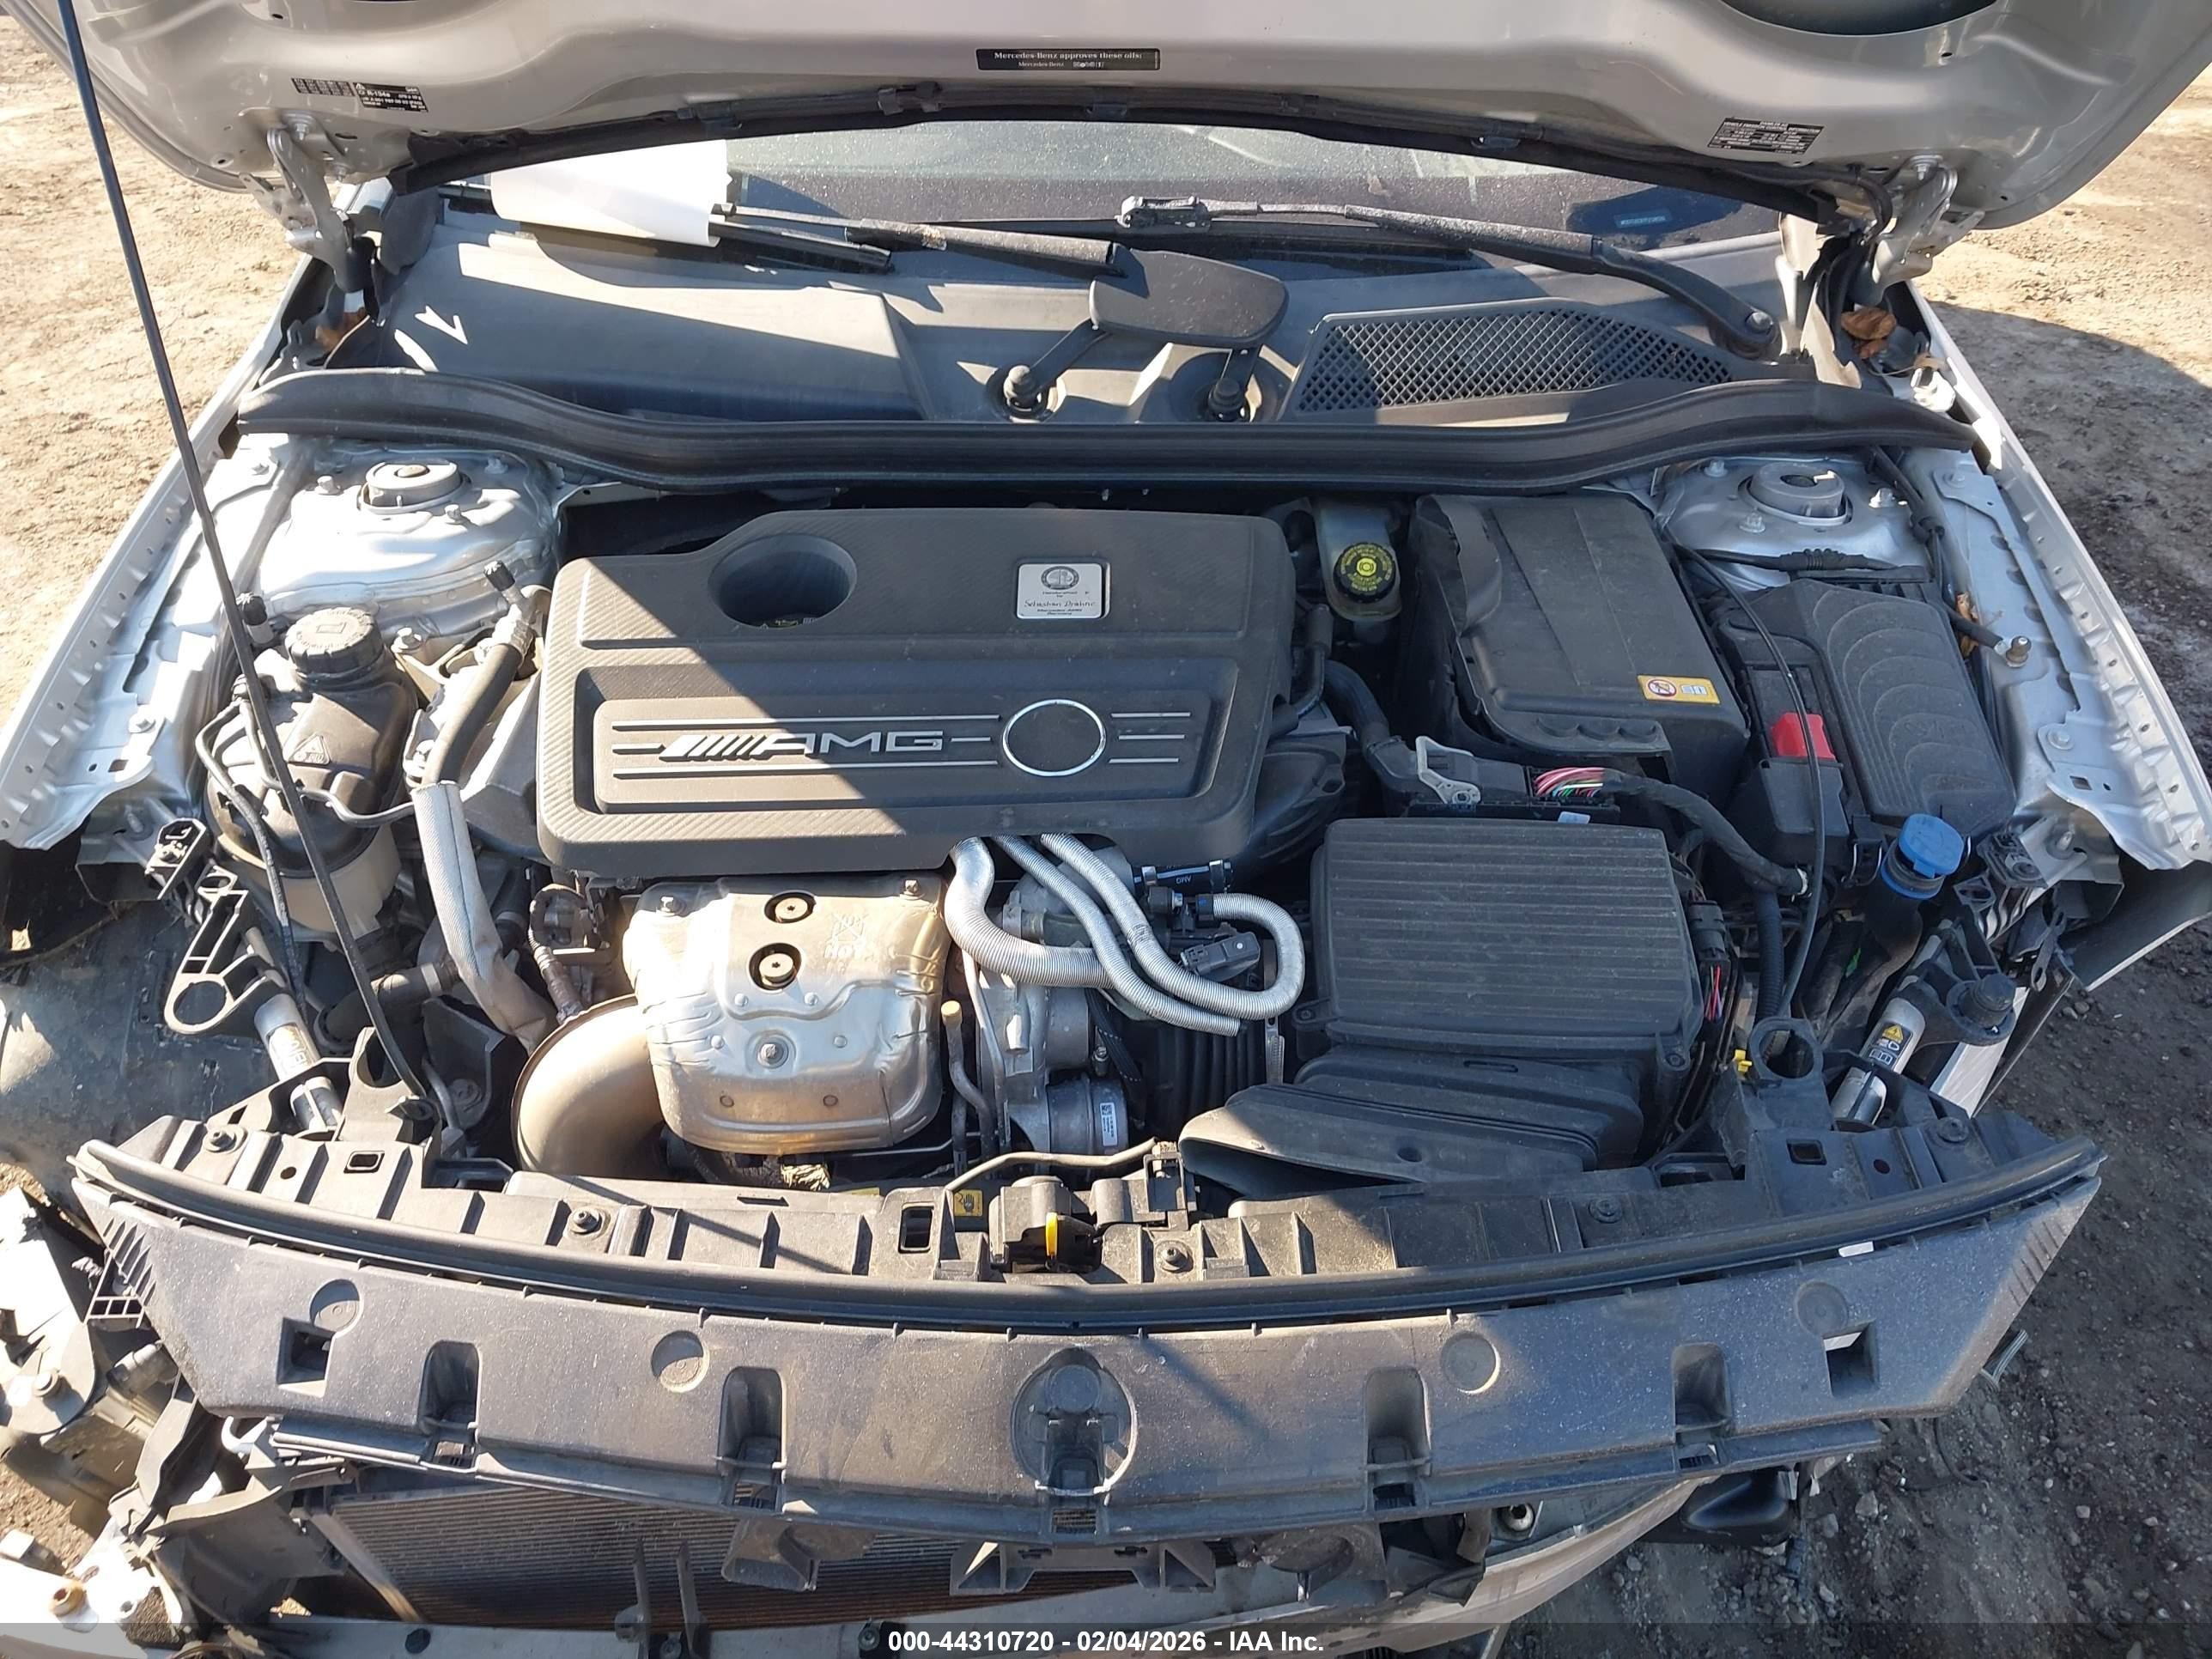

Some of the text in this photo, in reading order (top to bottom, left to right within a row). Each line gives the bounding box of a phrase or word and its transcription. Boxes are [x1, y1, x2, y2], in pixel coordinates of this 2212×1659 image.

[994, 52, 1058, 60] Mercedes-Benz
[1060, 52, 1098, 61] approves
[1099, 52, 1123, 60] these
[750, 730, 944, 757] AMG
